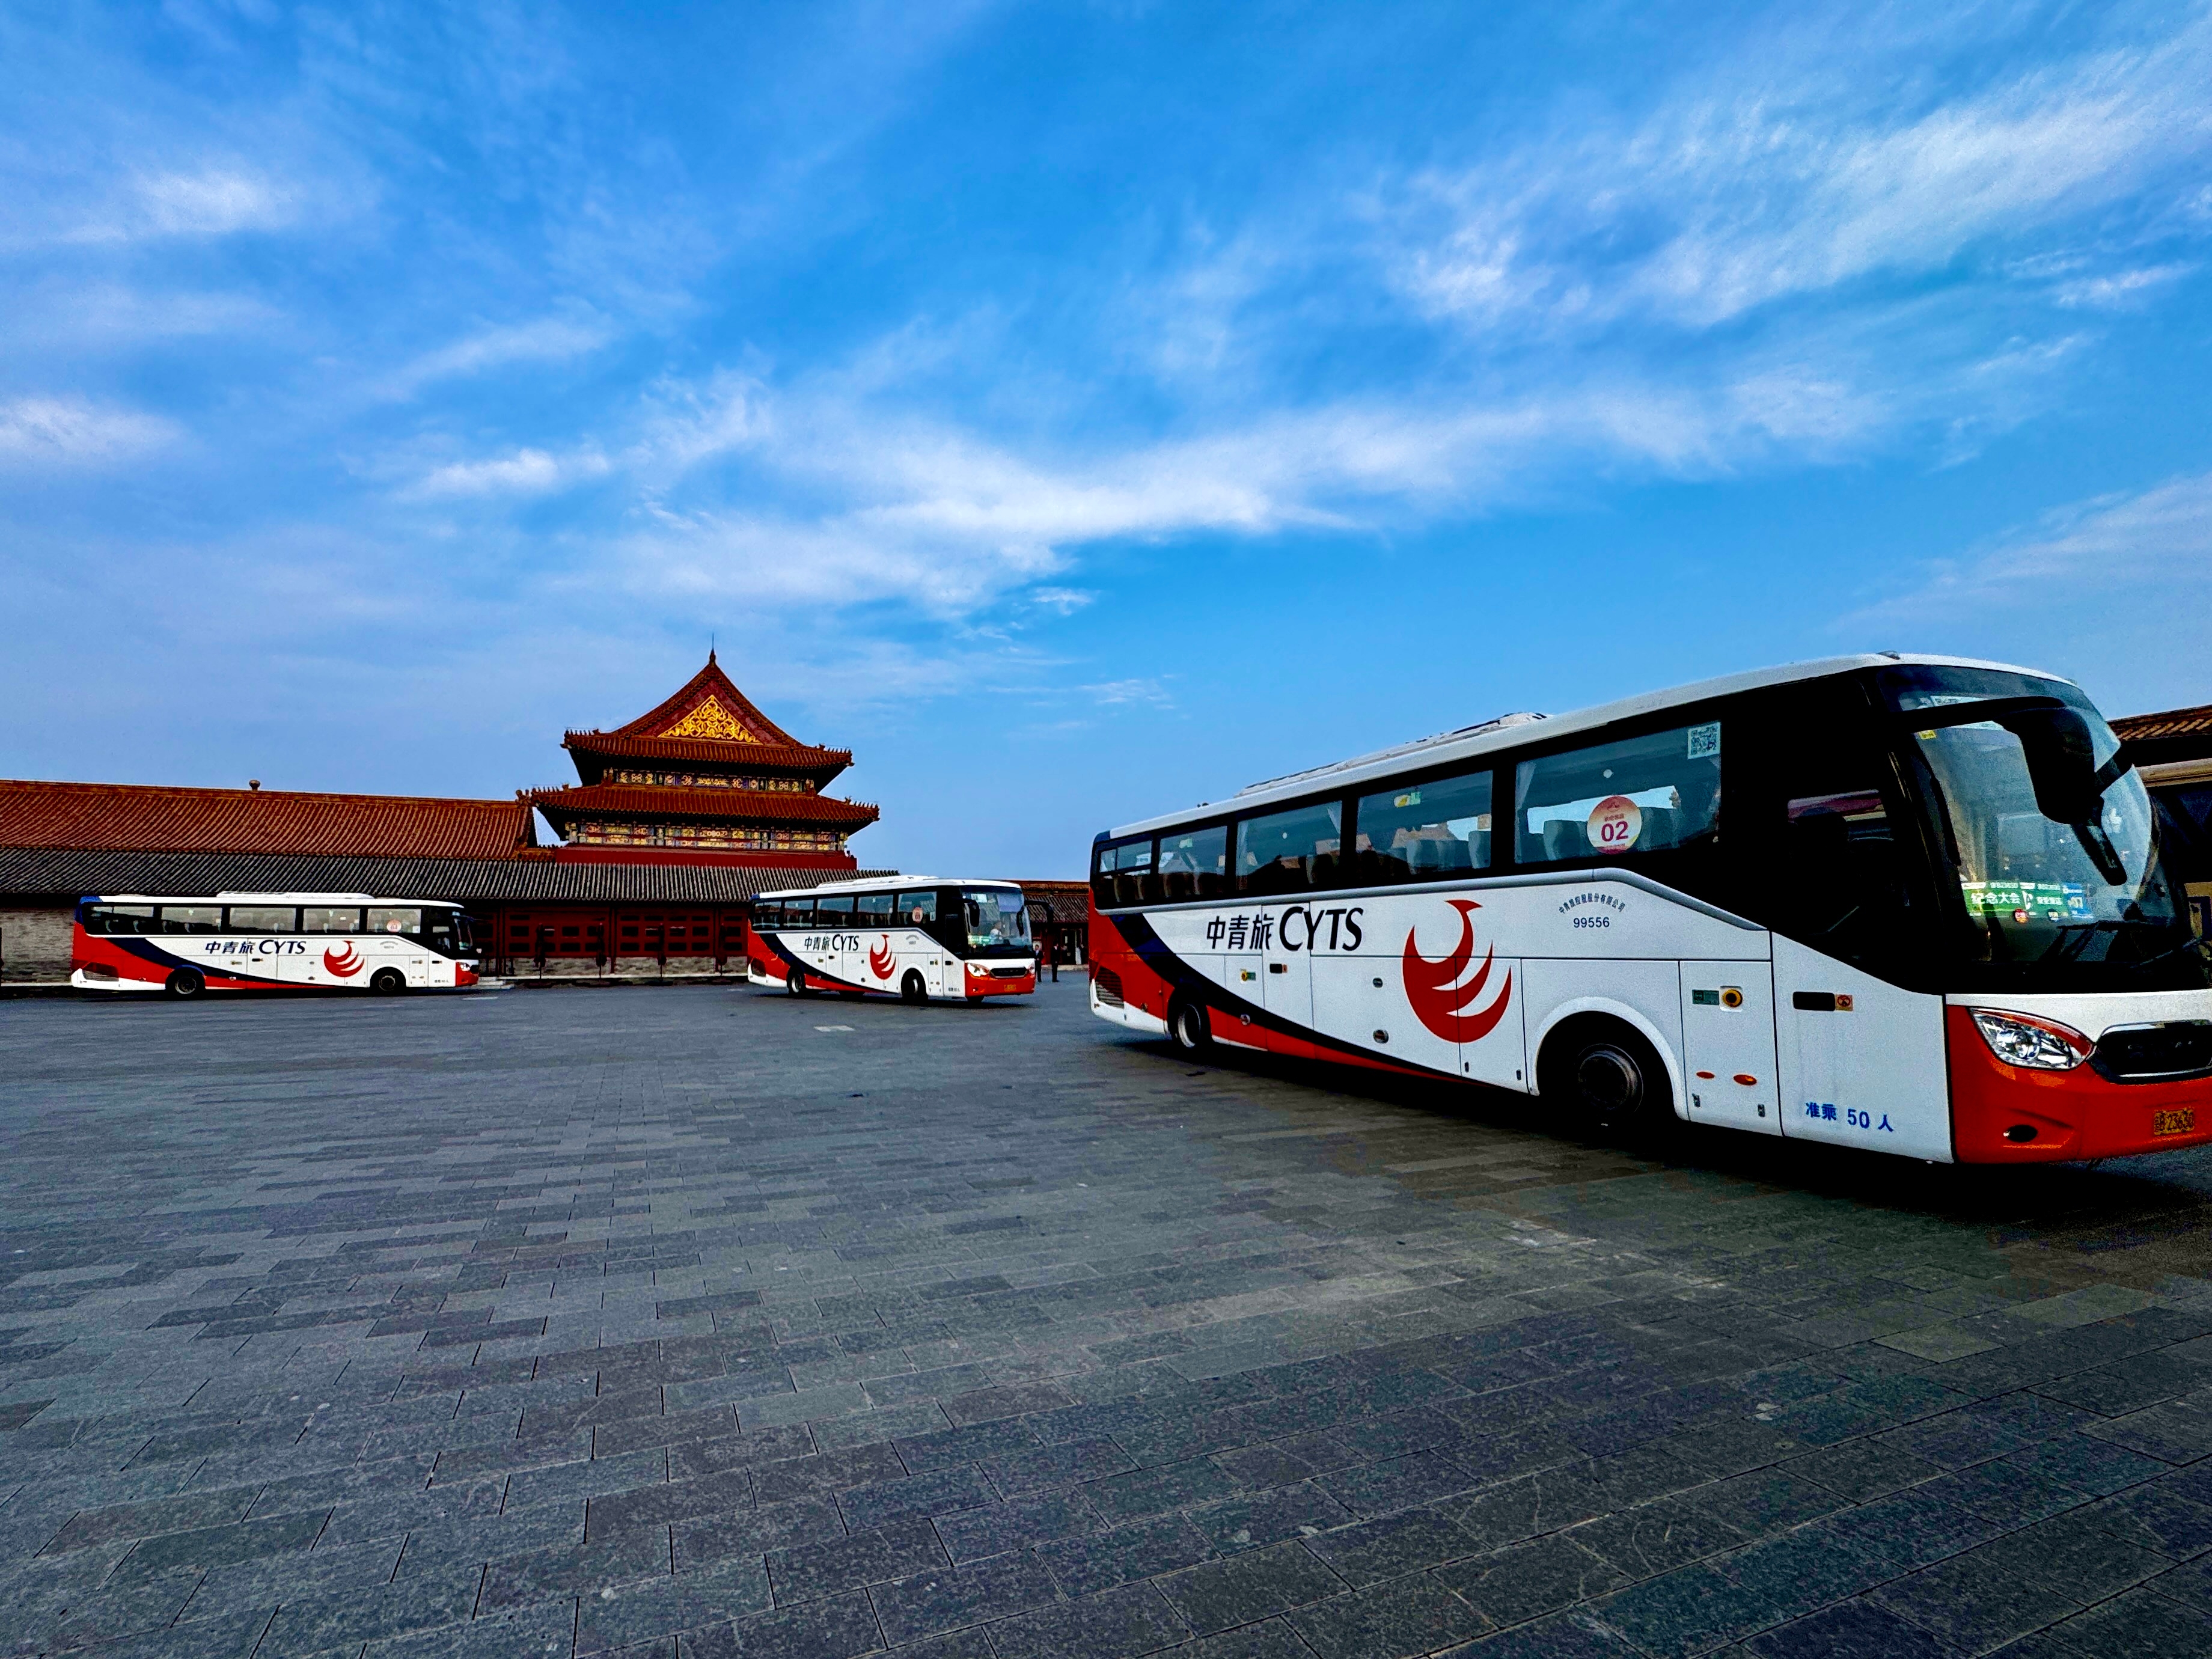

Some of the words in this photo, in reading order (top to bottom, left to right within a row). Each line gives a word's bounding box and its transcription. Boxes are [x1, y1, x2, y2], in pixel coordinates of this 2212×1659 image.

[1601, 820, 1629, 842] 02
[1206, 914, 1274, 950] 中青旅
[1279, 906, 1364, 952] CYTS
[1573, 916, 1610, 929] 99556
[205, 941, 256, 954] 中青旅
[258, 939, 307, 955] CYTS
[832, 933, 860, 951] CYTS
[1805, 1101, 1837, 1121] 准乘
[1847, 1108, 1870, 1129] 50
[1877, 1114, 1894, 1132] 人
